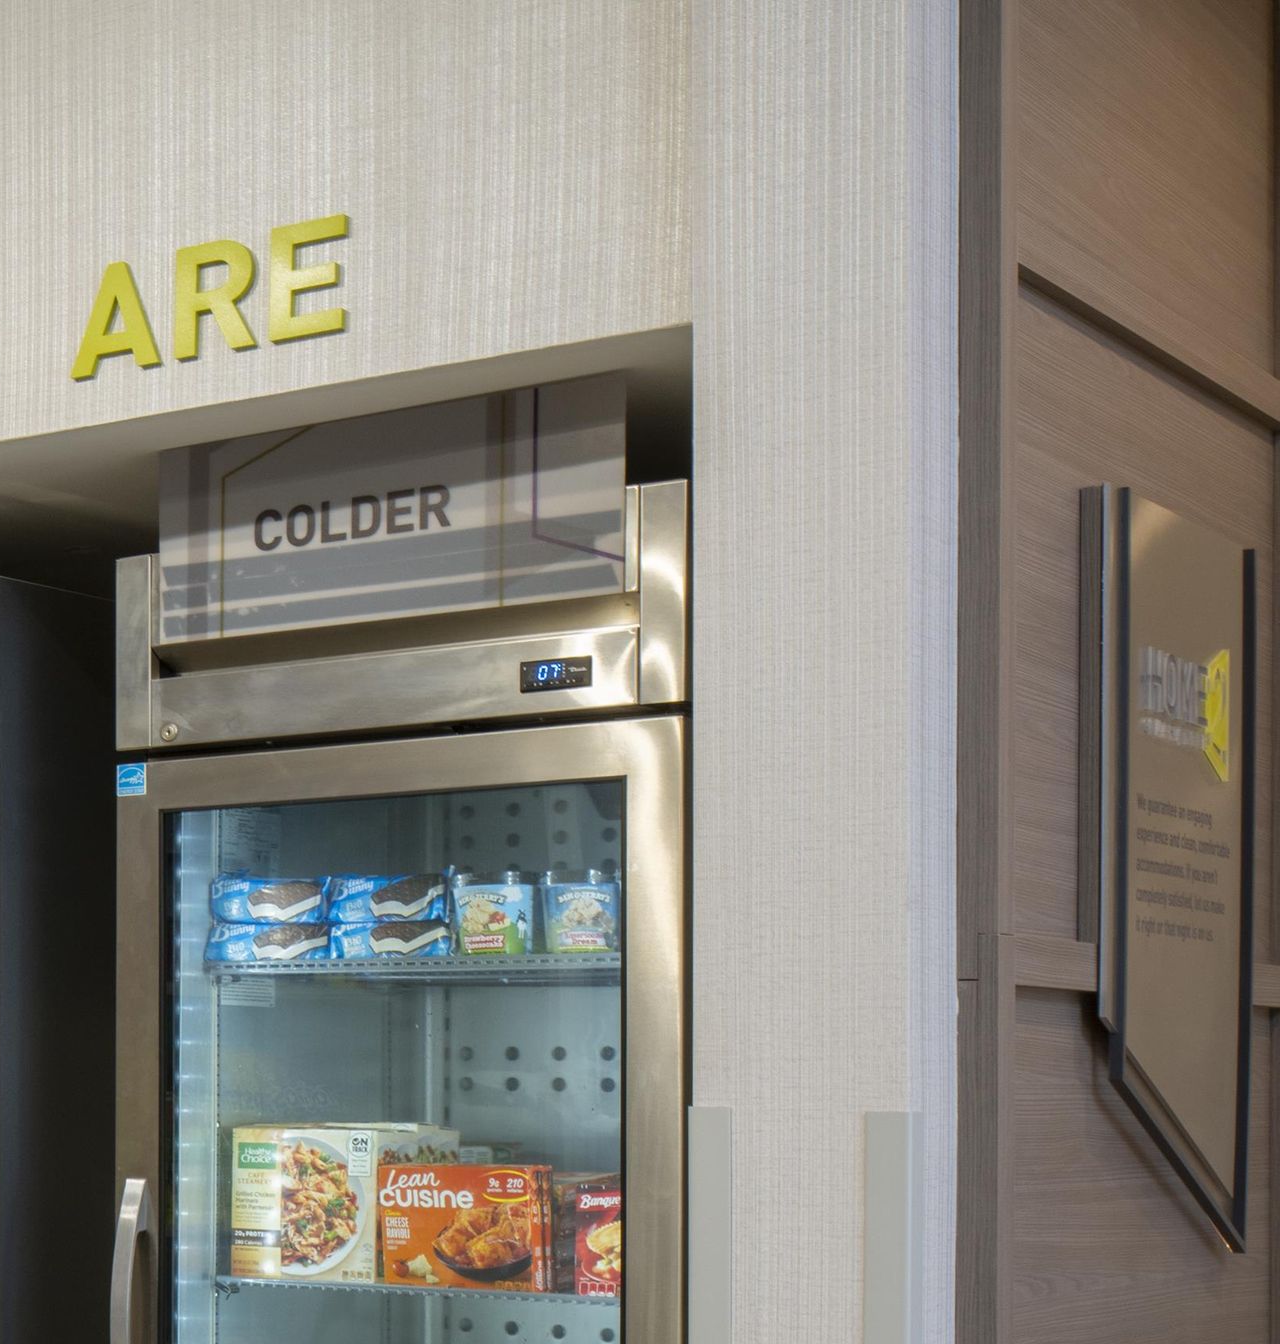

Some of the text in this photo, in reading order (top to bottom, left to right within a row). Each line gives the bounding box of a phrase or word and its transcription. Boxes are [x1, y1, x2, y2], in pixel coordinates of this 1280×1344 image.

[70, 212, 351, 382] ARE
[253, 484, 452, 552] COLDER
[386, 1168, 441, 1190] Lean
[385, 1216, 410, 1228] CHEESE
[386, 1227, 411, 1239] RAVIOLI
